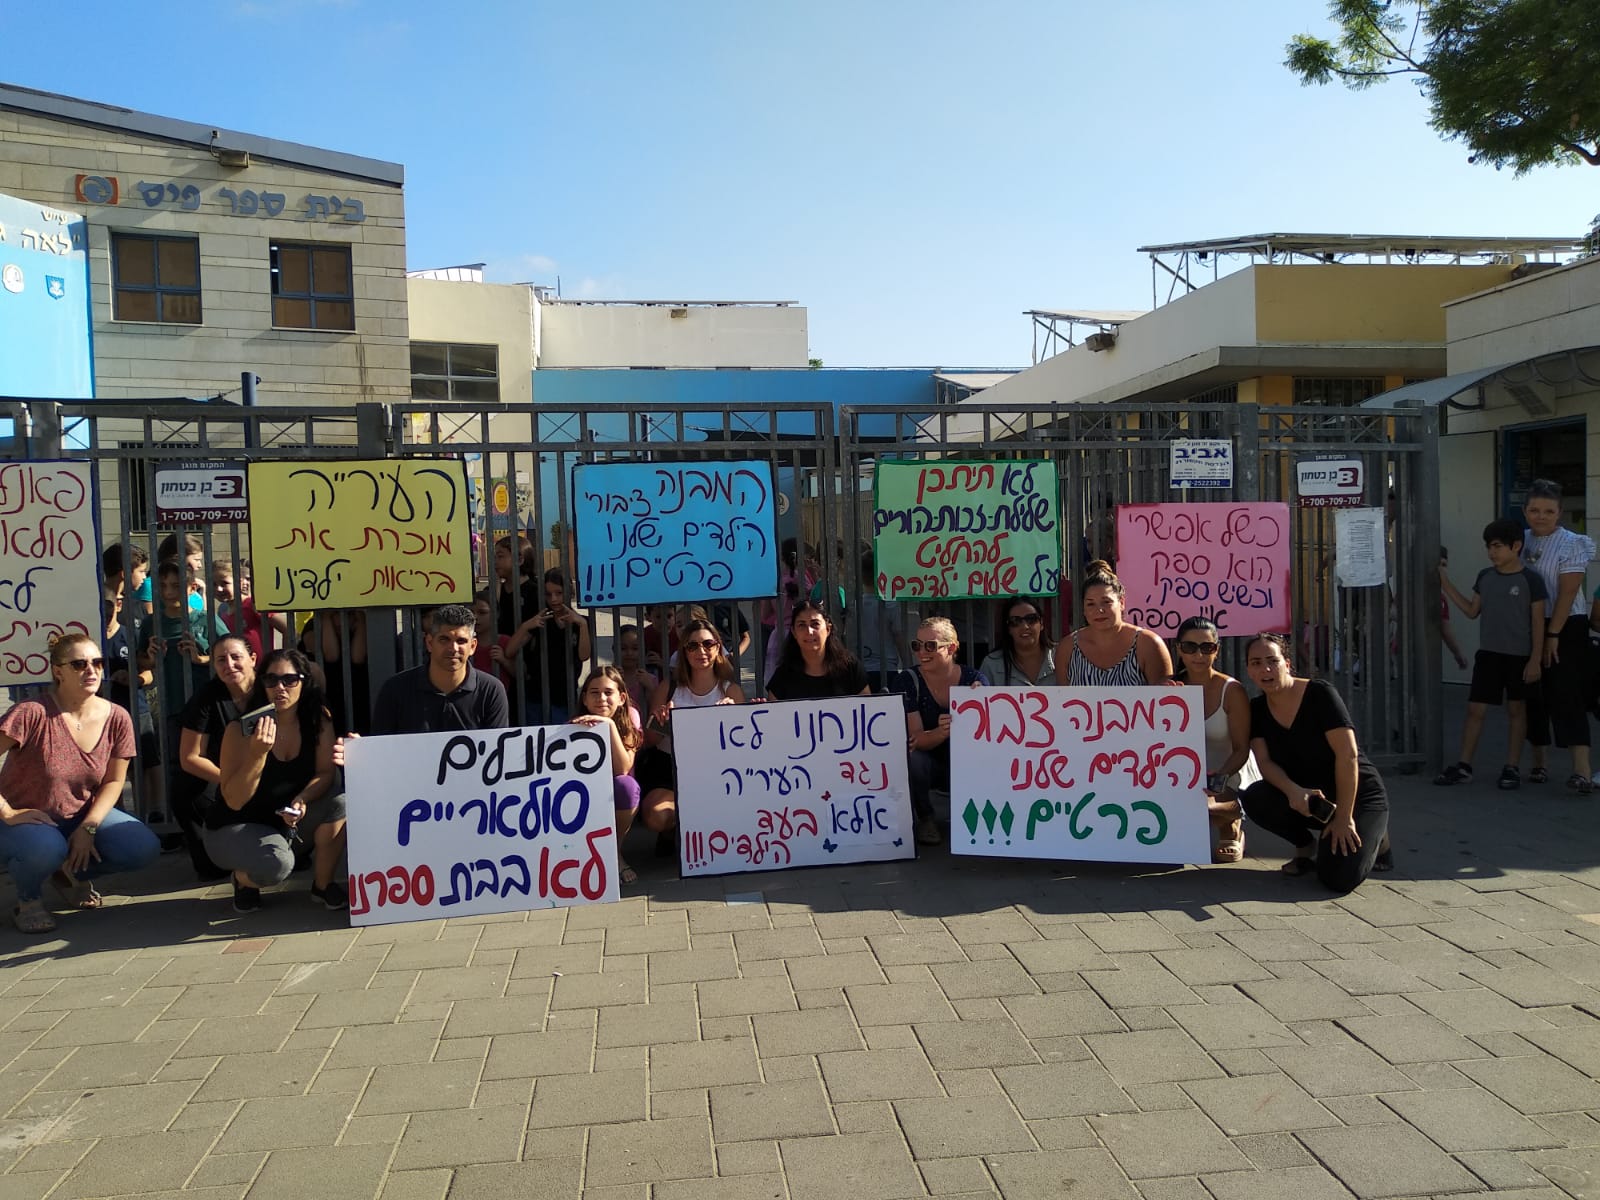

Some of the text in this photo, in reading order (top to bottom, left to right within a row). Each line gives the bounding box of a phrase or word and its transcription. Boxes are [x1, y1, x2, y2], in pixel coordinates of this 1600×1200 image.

[137, 180, 366, 222] בית ספר פיס
[1175, 447, 1229, 458] אביב
[161, 482, 196, 495] בטחון
[200, 482, 212, 494] בן
[585, 469, 767, 517] המבנה ציבורי
[916, 462, 1038, 504] לא תיתכן
[1301, 471, 1326, 483] בטחון
[1329, 471, 1337, 481] בן
[161, 510, 248, 521] 1-700-709-707
[1300, 497, 1361, 506] 1-700-709-707
[274, 522, 452, 556] מוכרת את
[606, 516, 767, 560] הילדים שלנו
[1128, 508, 1280, 548] כשל אפשרי
[916, 532, 1009, 568] להחליט
[1151, 551, 1273, 586] הוא ספק
[268, 559, 456, 606] בריאות ילדינו
[968, 557, 1018, 596] שלום
[1029, 554, 1059, 593] על
[1217, 581, 1274, 609] וכשיש
[1128, 607, 1181, 630] ספק
[719, 703, 890, 760] אנחנו לא
[951, 691, 1190, 748] המבנה ציבורי
[436, 727, 607, 786] פאנלים
[839, 761, 889, 791] נגד
[1010, 742, 1201, 791] הילדים שלנו
[398, 777, 590, 846] סולאריים
[757, 795, 889, 840] אלא בעד
[350, 826, 613, 915] לא בבית ספרנו
